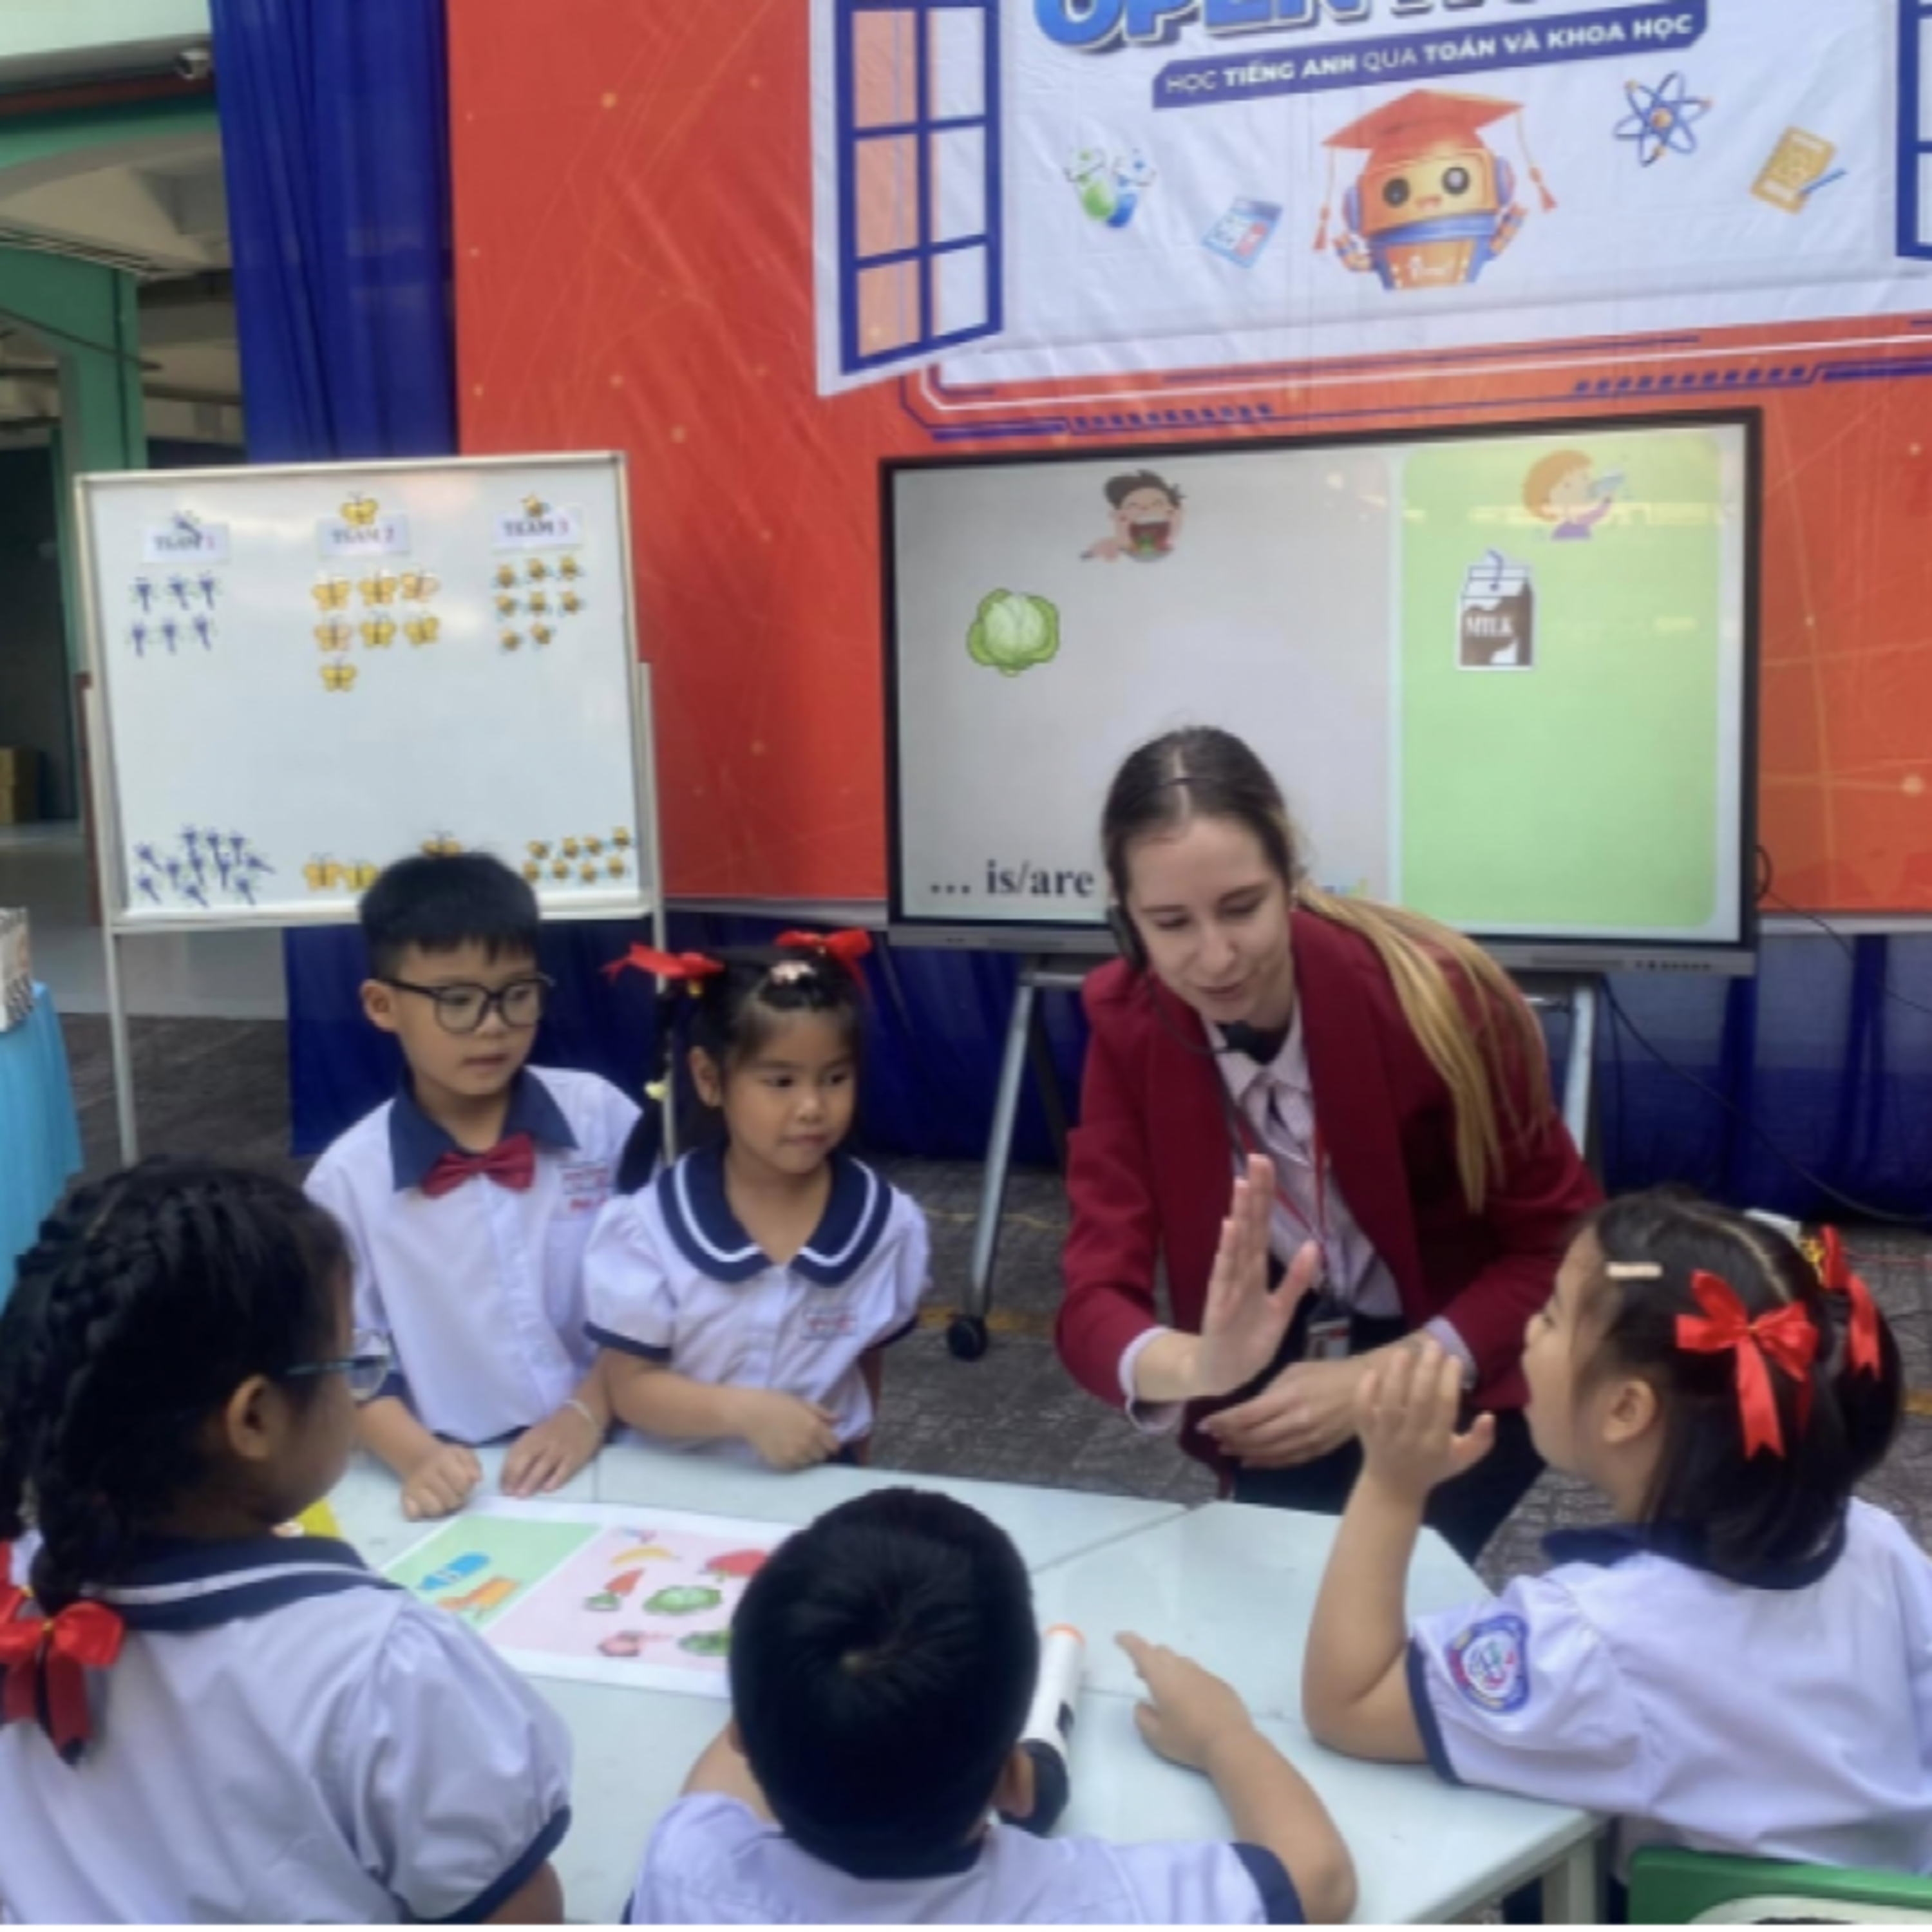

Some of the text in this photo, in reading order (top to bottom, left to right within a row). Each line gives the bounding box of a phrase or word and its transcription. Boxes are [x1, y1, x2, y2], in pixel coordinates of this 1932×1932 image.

[1166, 14, 1693, 95] HỌC TIẾNG ANH QUA TOÁN VÀ KHOA HỌC
[504, 520, 554, 536] TEAM
[1466, 615, 1514, 638] MILK
[986, 858, 1095, 897] is/are
